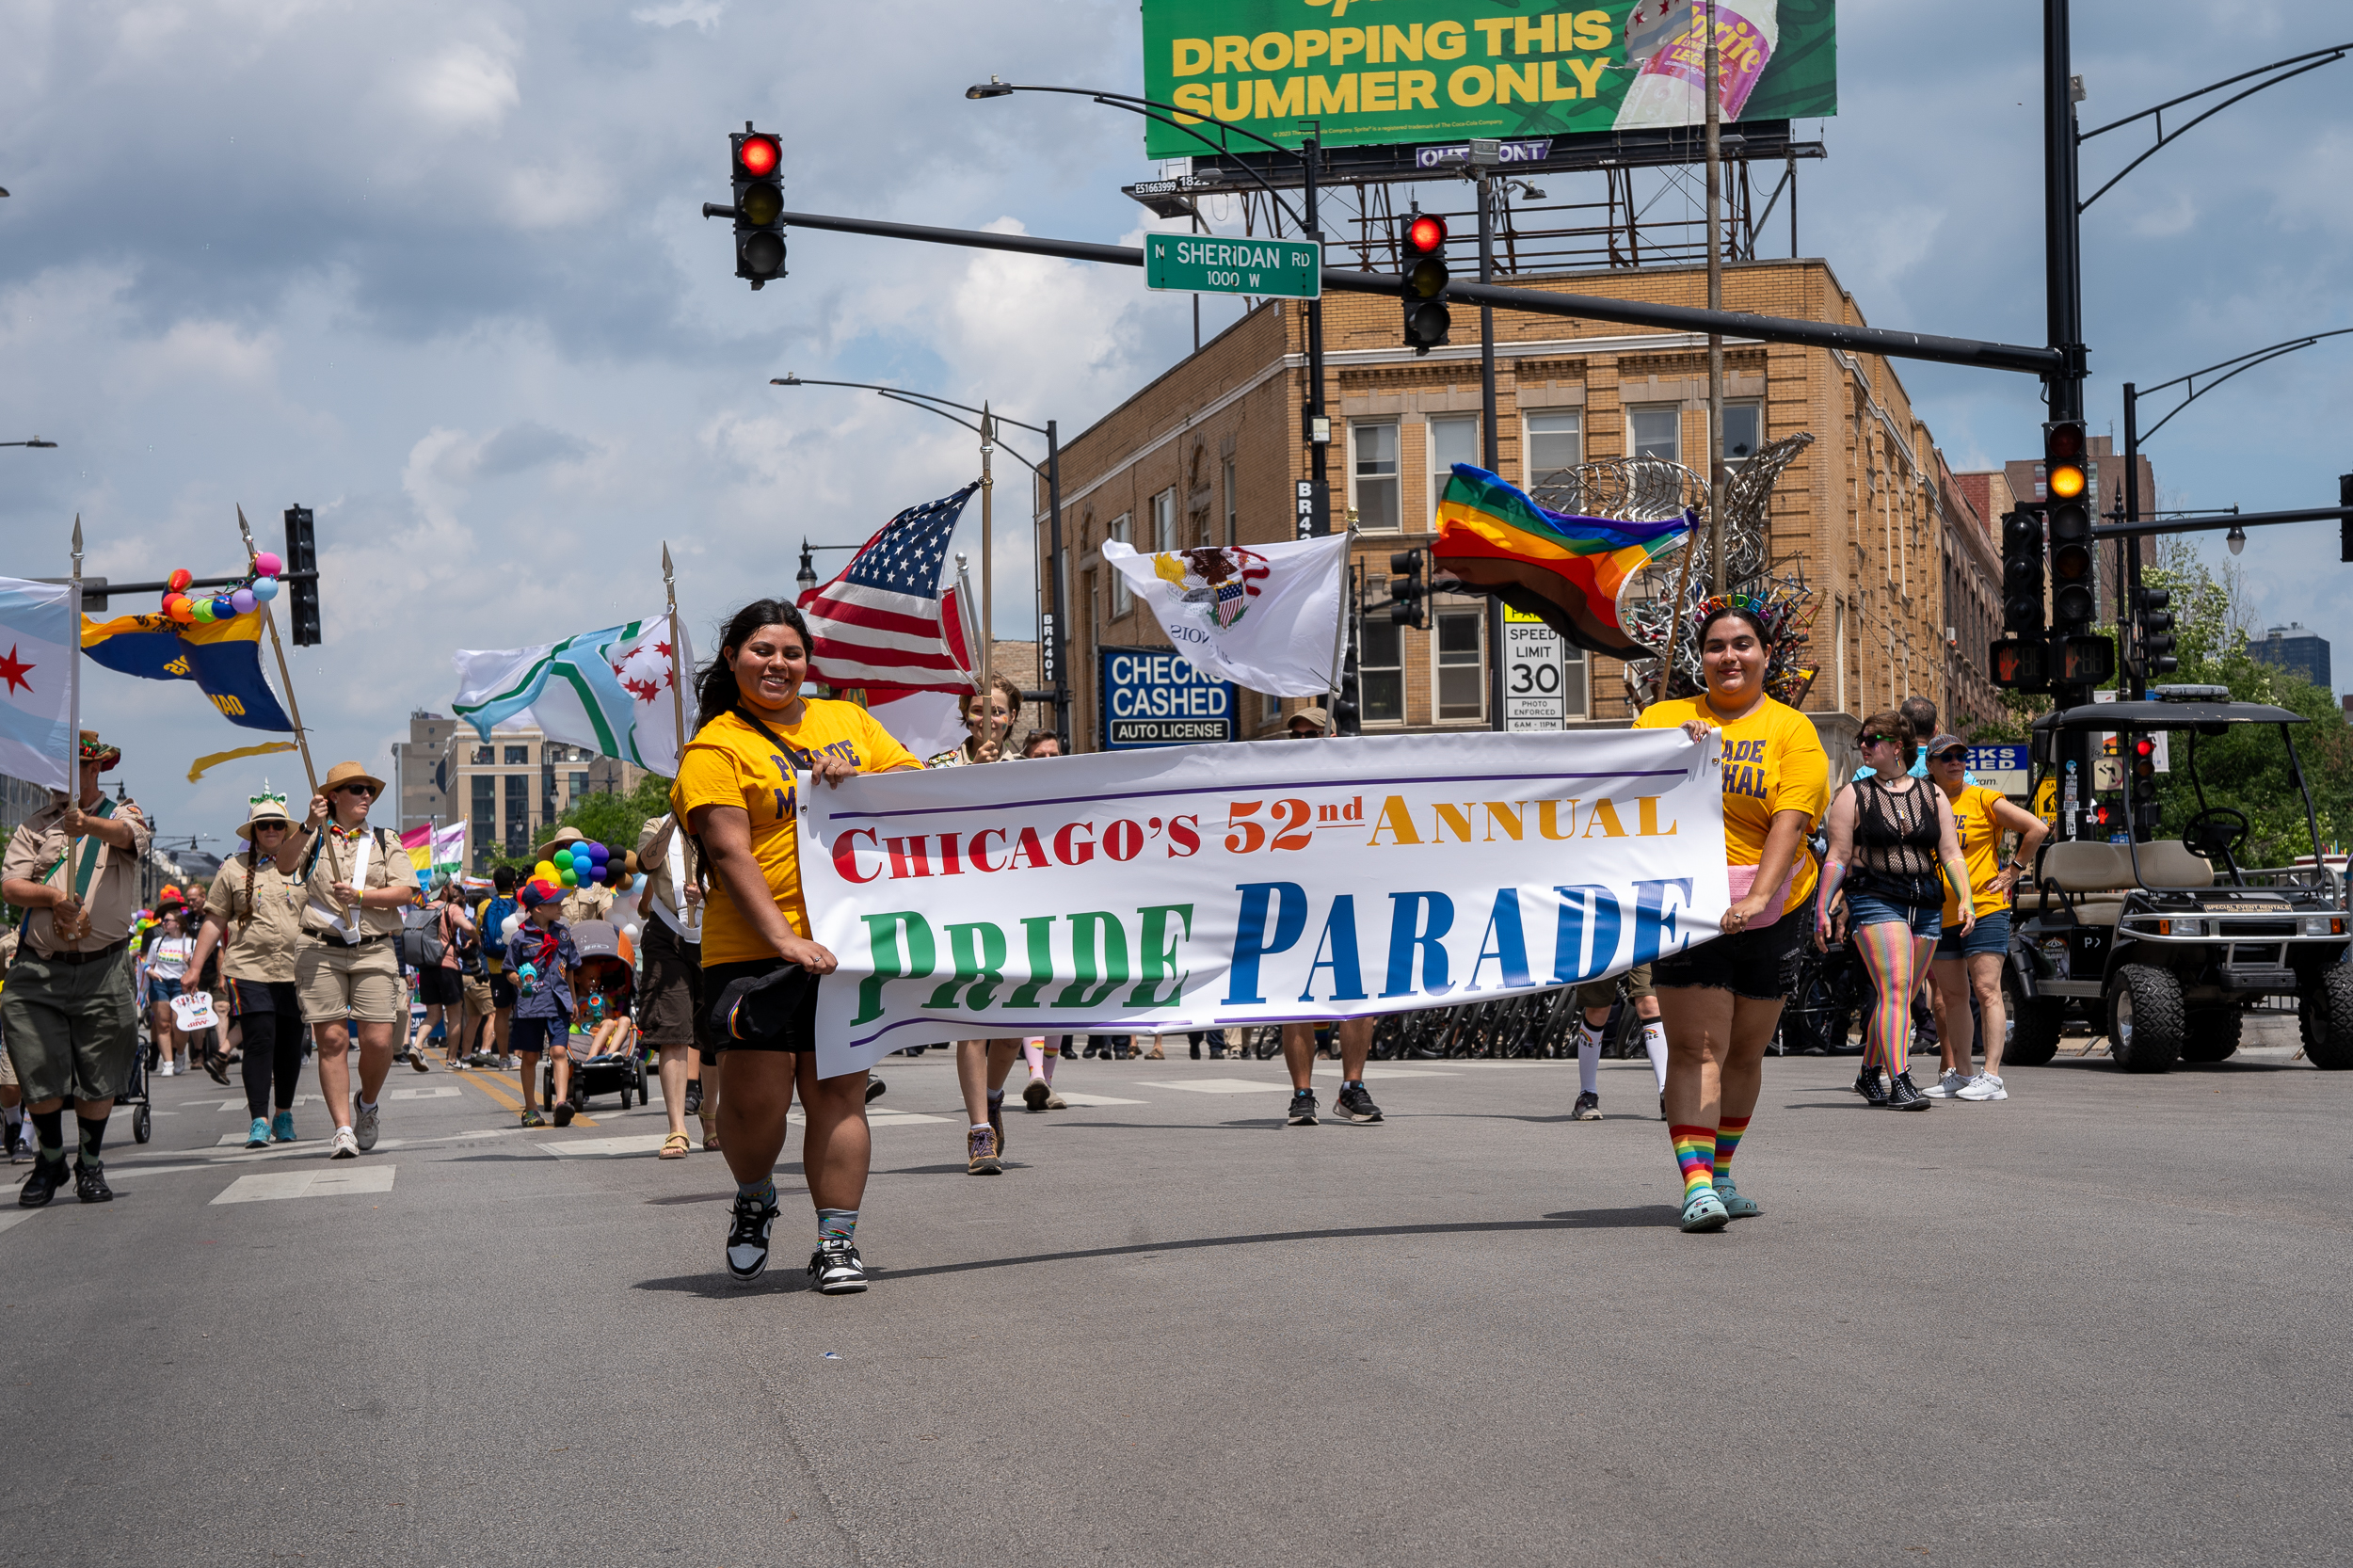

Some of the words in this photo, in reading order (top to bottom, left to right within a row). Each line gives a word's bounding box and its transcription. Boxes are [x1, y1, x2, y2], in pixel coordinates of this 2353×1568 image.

[1173, 21, 1466, 77] DROPPING
[1474, 9, 1612, 56] THIS
[1173, 70, 1440, 125] SUMMER
[1448, 57, 1611, 107] ONLY
[1135, 181, 1176, 194] ES1663999
[1155, 244, 1165, 258] N
[1176, 242, 1280, 269] SHERIDAN
[1291, 252, 1310, 267] RD
[1207, 271, 1240, 287] 1000
[1249, 273, 1260, 288] W
[1697, 594, 1764, 615] PRIDE
[1043, 614, 1054, 680] BR4401
[1510, 629, 1558, 640] SPEED
[1516, 647, 1551, 658] LIMIT
[1511, 664, 1560, 694] 30
[1112, 687, 1226, 717] CASHED
[1118, 724, 1159, 739] AUTO
[1161, 723, 1224, 738] LICENSE
[832, 814, 1201, 884] CHICAGO’S
[1225, 796, 1365, 854] 52nd
[1367, 795, 1677, 846] ANNUAL
[850, 904, 1193, 1027] PRIDE
[1220, 877, 1694, 1005] PARADE
